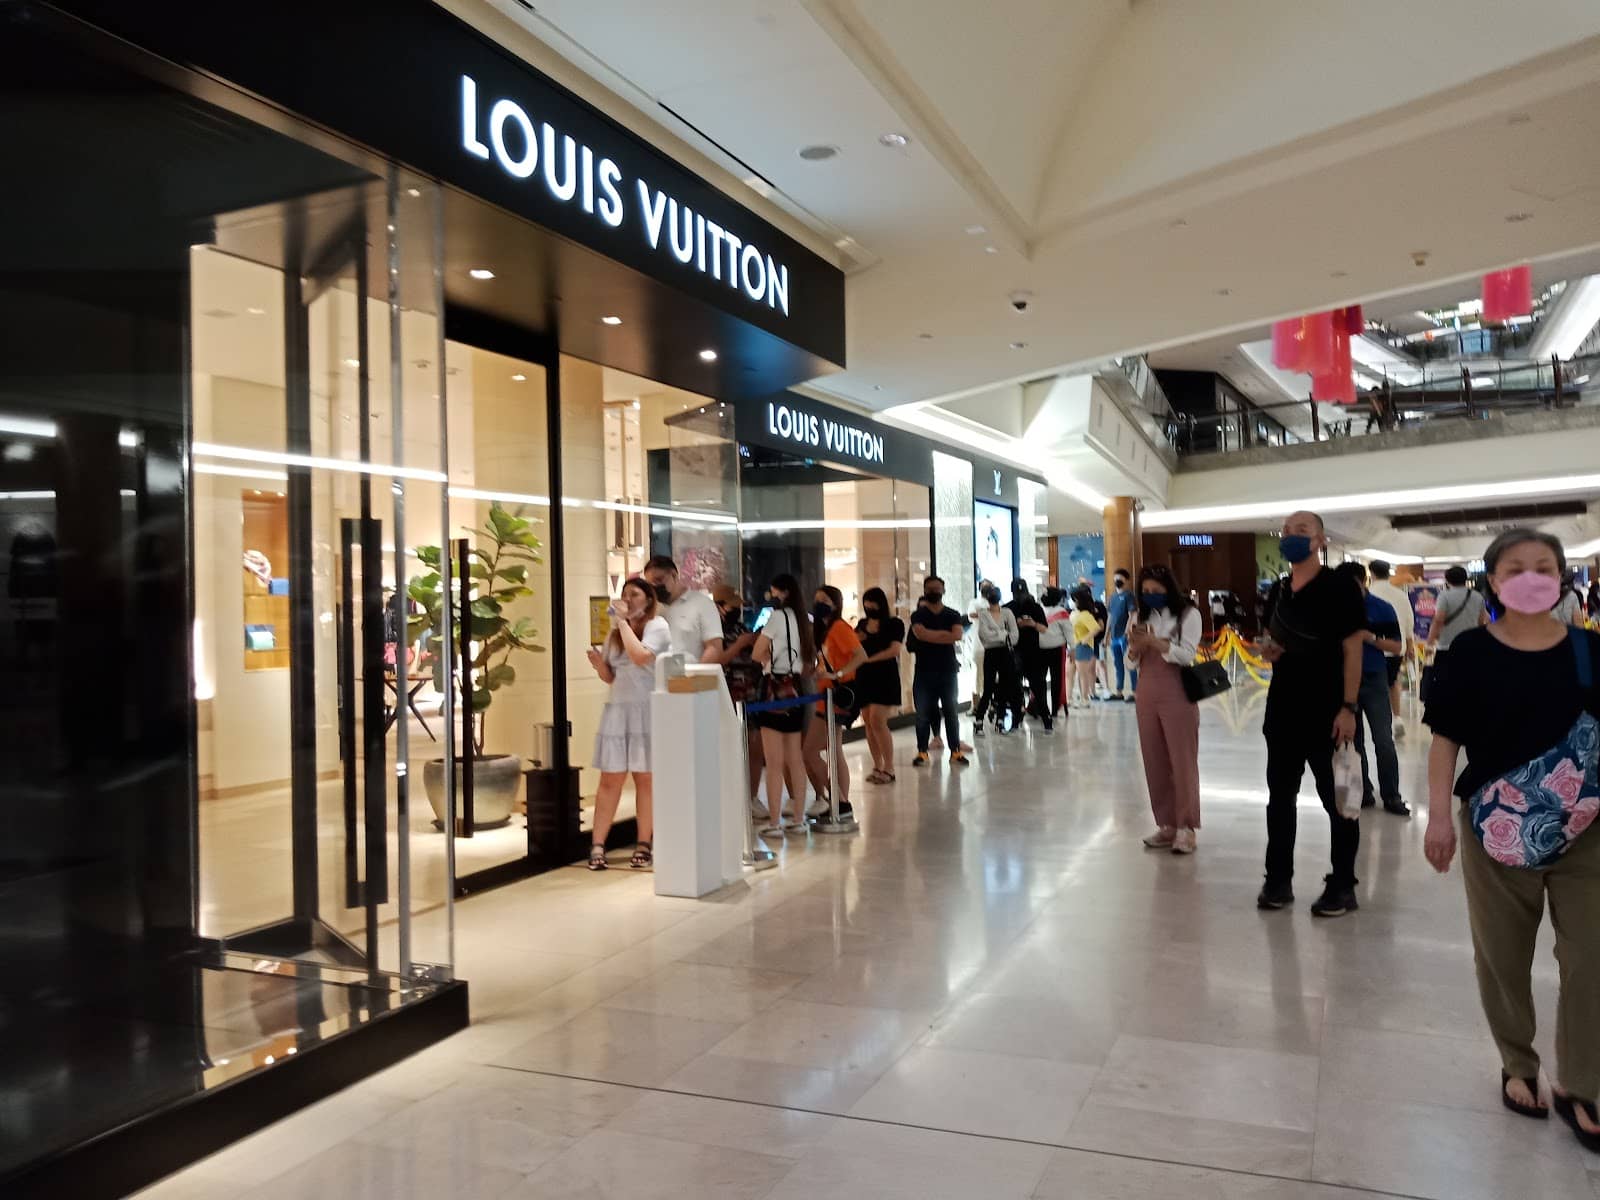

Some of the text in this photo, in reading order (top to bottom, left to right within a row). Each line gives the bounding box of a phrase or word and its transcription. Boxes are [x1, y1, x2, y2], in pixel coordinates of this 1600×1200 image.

[462, 74, 790, 318] LOUIS VUITTON
[768, 402, 884, 465] LOUIS VUITTON
